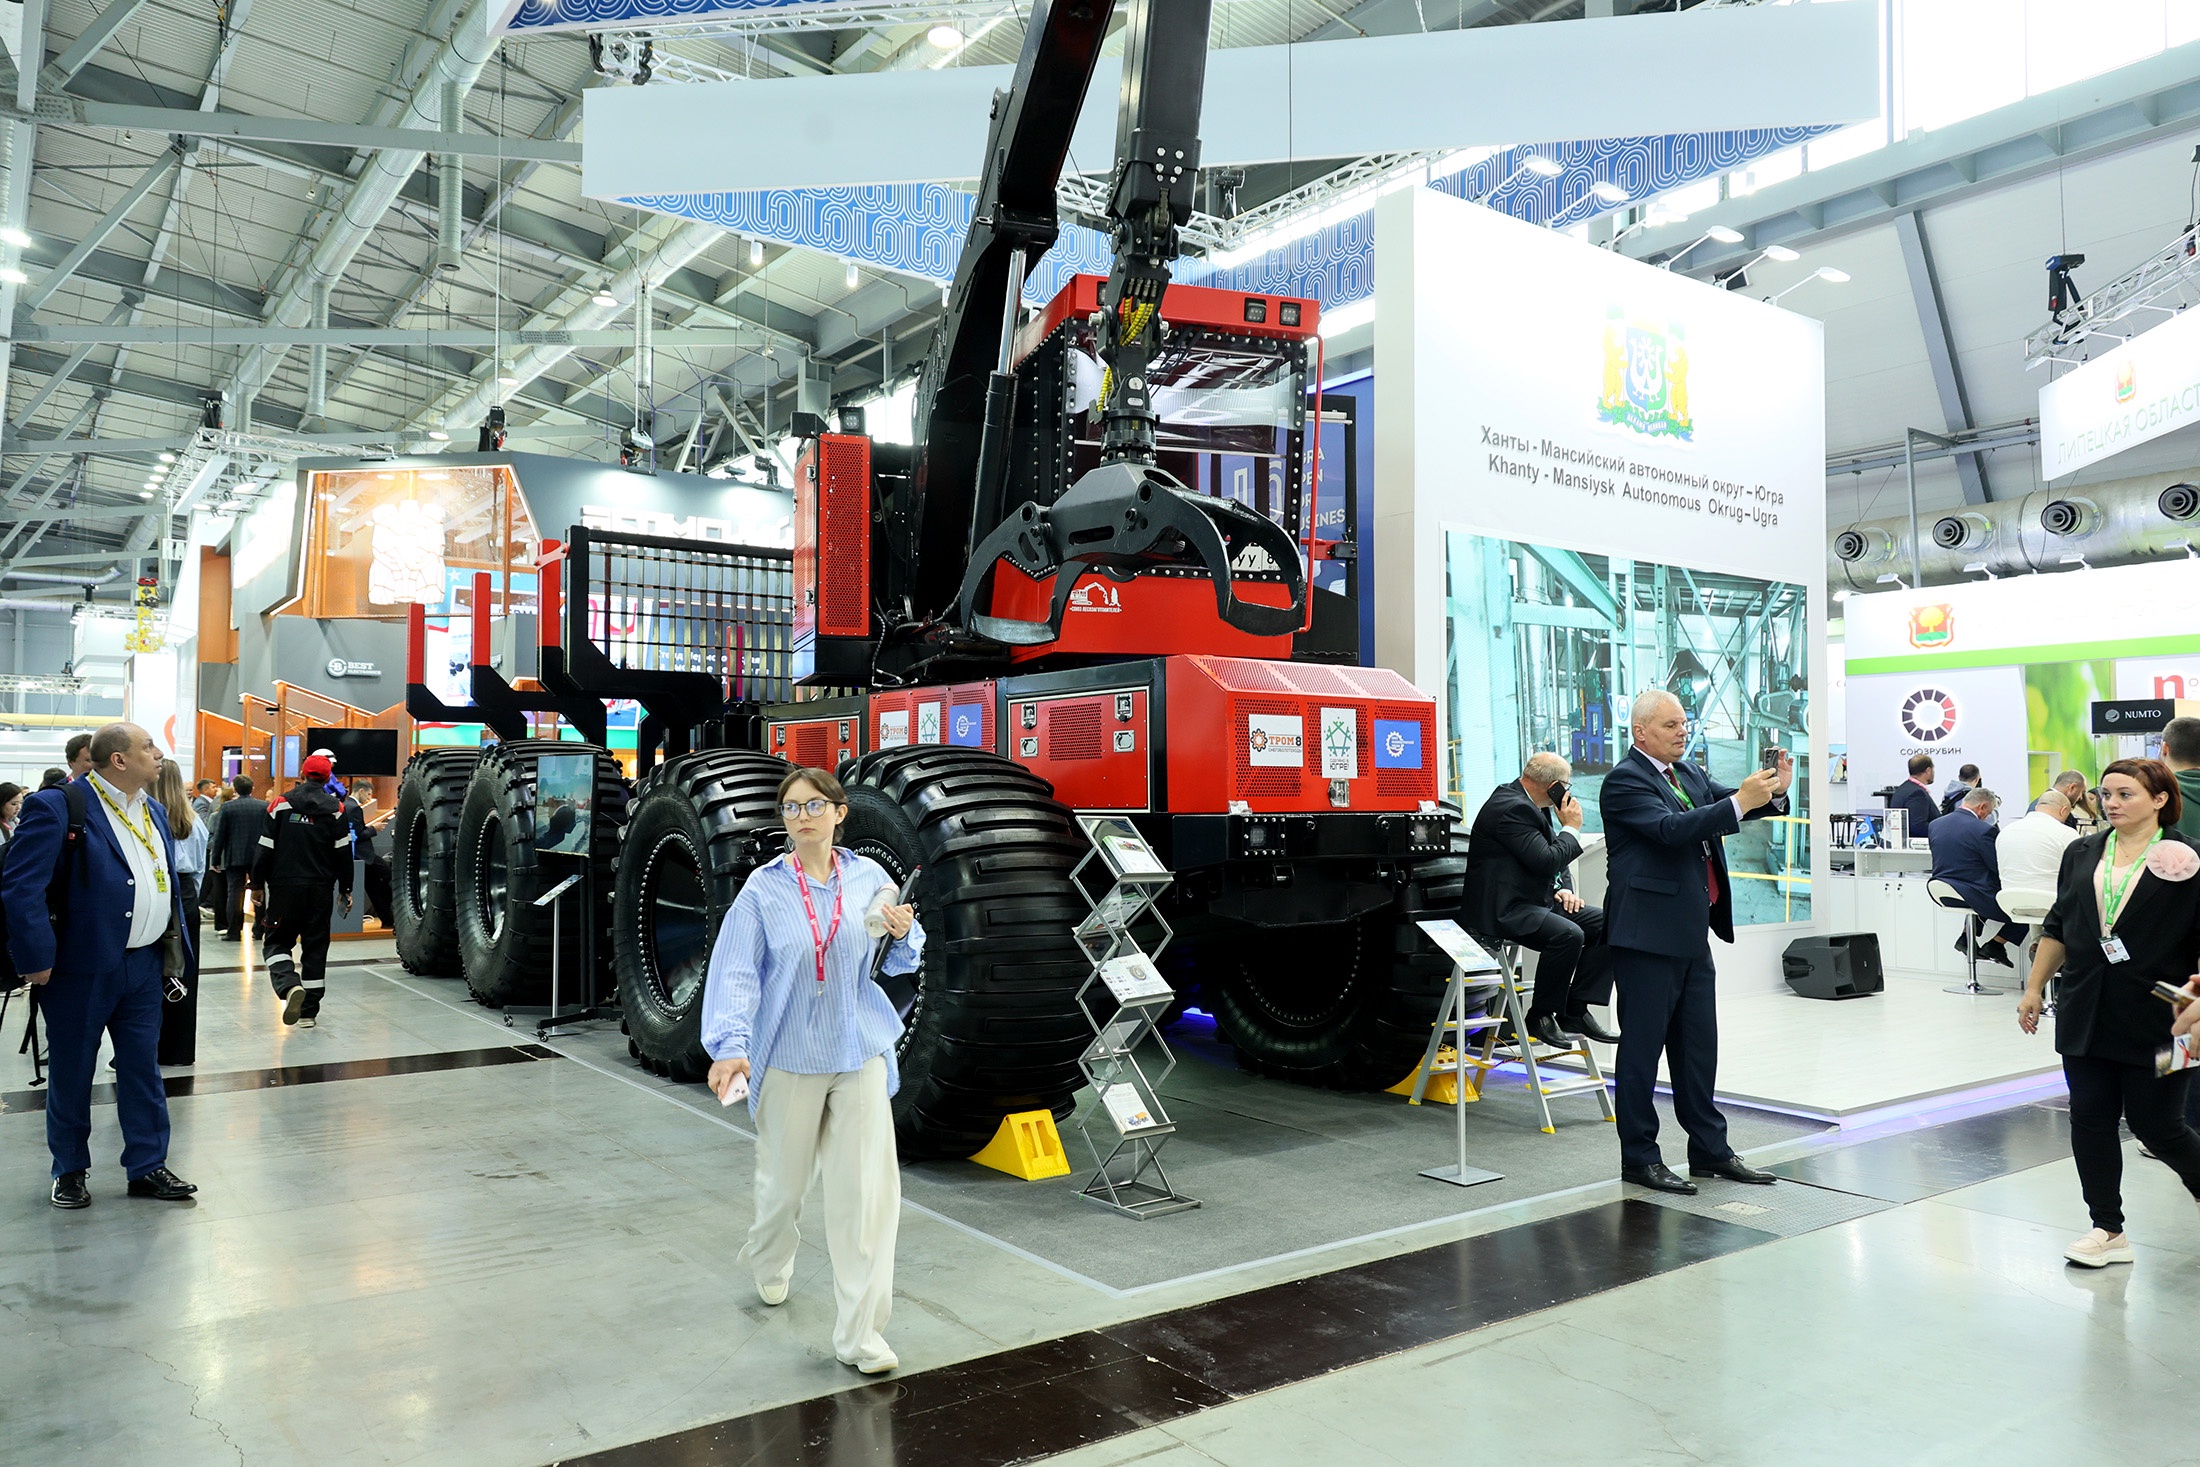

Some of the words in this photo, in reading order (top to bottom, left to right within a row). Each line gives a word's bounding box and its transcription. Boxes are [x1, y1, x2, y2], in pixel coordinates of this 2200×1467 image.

[2058, 418, 2132, 465] ЛИПЕЦКАЯ
[1481, 425, 1529, 453] Ханты
[1541, 438, 1625, 473] Мансийский
[1629, 462, 1709, 490] автономный
[1488, 453, 1540, 484] Khanty
[1553, 467, 1615, 496] Mansiysk
[1622, 481, 1701, 511] Autonomous
[2124, 709, 2162, 719] NUMTO
[1268, 736, 1295, 746] ТРОМ
[1295, 736, 1302, 747] 8
[1899, 747, 1962, 756] СОЮЗРУБИН
